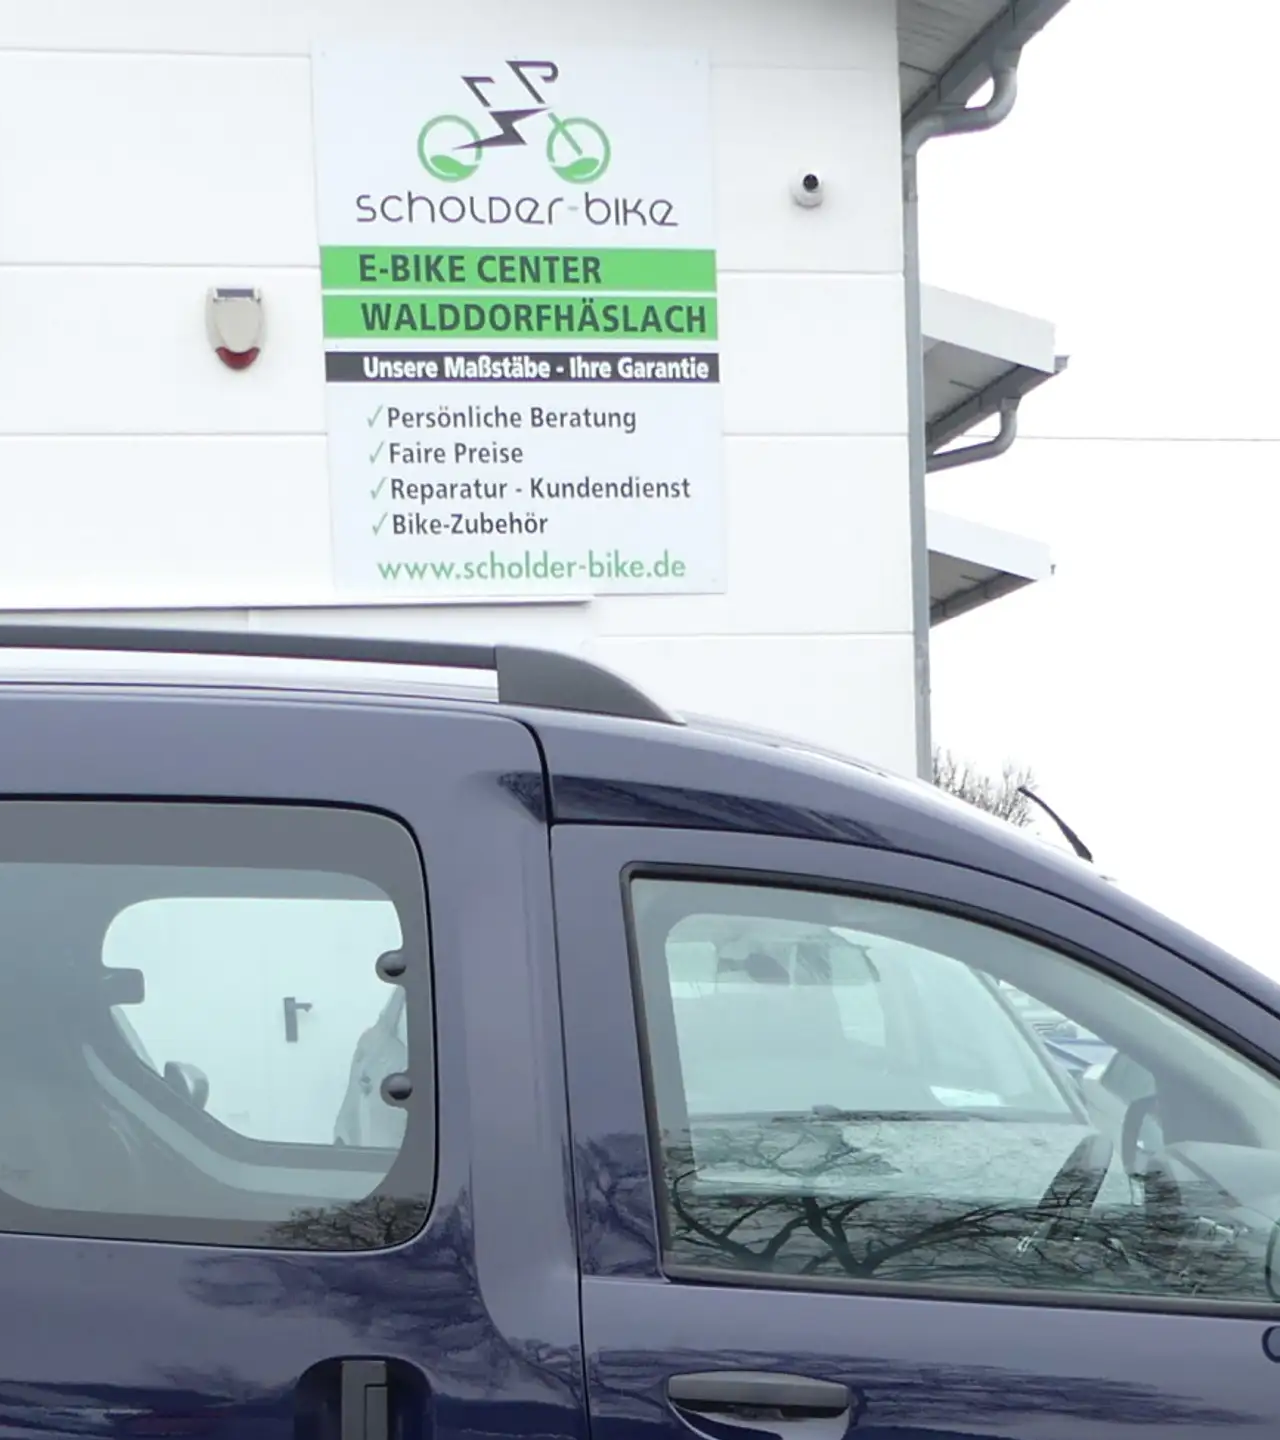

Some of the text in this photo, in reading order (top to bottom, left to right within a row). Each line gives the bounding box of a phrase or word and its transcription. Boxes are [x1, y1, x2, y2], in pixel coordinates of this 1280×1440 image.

[358, 253, 602, 285] E-BIKE CENTER
[361, 297, 707, 333] WALDDORFHÄSLACH
[363, 356, 438, 378] Unsere
[444, 356, 550, 380] Maßstäbe
[570, 358, 611, 379] Ihre
[618, 358, 709, 380] Garantie
[387, 406, 636, 433] Persönliche Beratung
[389, 443, 524, 464] Faire Preise
[390, 479, 507, 504] Reparatur
[530, 477, 691, 498] Kundendienst
[393, 513, 548, 535] Bike-Zubehör
[377, 550, 687, 580] www.scholder-bike.de
